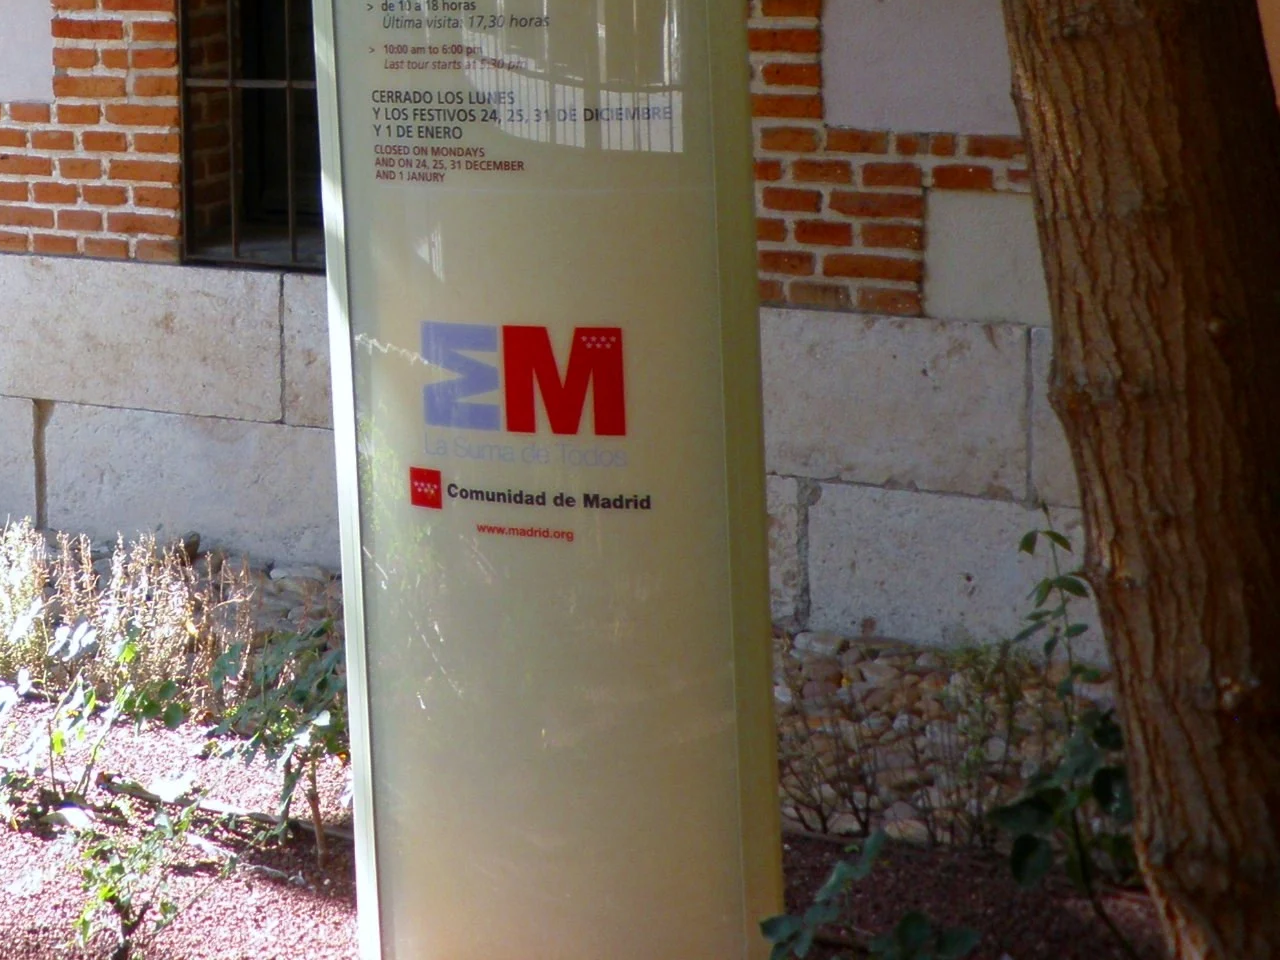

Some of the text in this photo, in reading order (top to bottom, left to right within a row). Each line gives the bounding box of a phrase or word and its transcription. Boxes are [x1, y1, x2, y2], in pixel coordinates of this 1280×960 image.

[380, 0, 477, 12] de 10 a 18 horas
[382, 13, 551, 31] Última visita: 17,30 horas
[383, 44, 409, 55] 10:00
[410, 46, 426, 55] am
[428, 45, 440, 55] to
[441, 44, 464, 55] 6:00
[383, 58, 405, 71] Last
[406, 59, 430, 71] tour
[431, 59, 463, 71] starts
[371, 90, 516, 106] CERRADO LOS LUNES
[372, 105, 673, 124] Y LOS FESTIVOS 24, 25, 31 DE DICIEMBRE
[373, 124, 464, 140] Y 1 DE ENERO
[374, 144, 486, 158] CLOSED ON MONDAYS
[374, 158, 396, 169] AND
[397, 158, 414, 169] ON
[449, 160, 463, 171] 31
[464, 160, 525, 172] DECEMBER
[375, 170, 446, 183] AND 1 JANURY
[423, 432, 448, 457] La
[452, 435, 516, 464] Suma
[446, 483, 652, 511] Comunidad de Madrid
[476, 522, 575, 542] www.madrid.org
